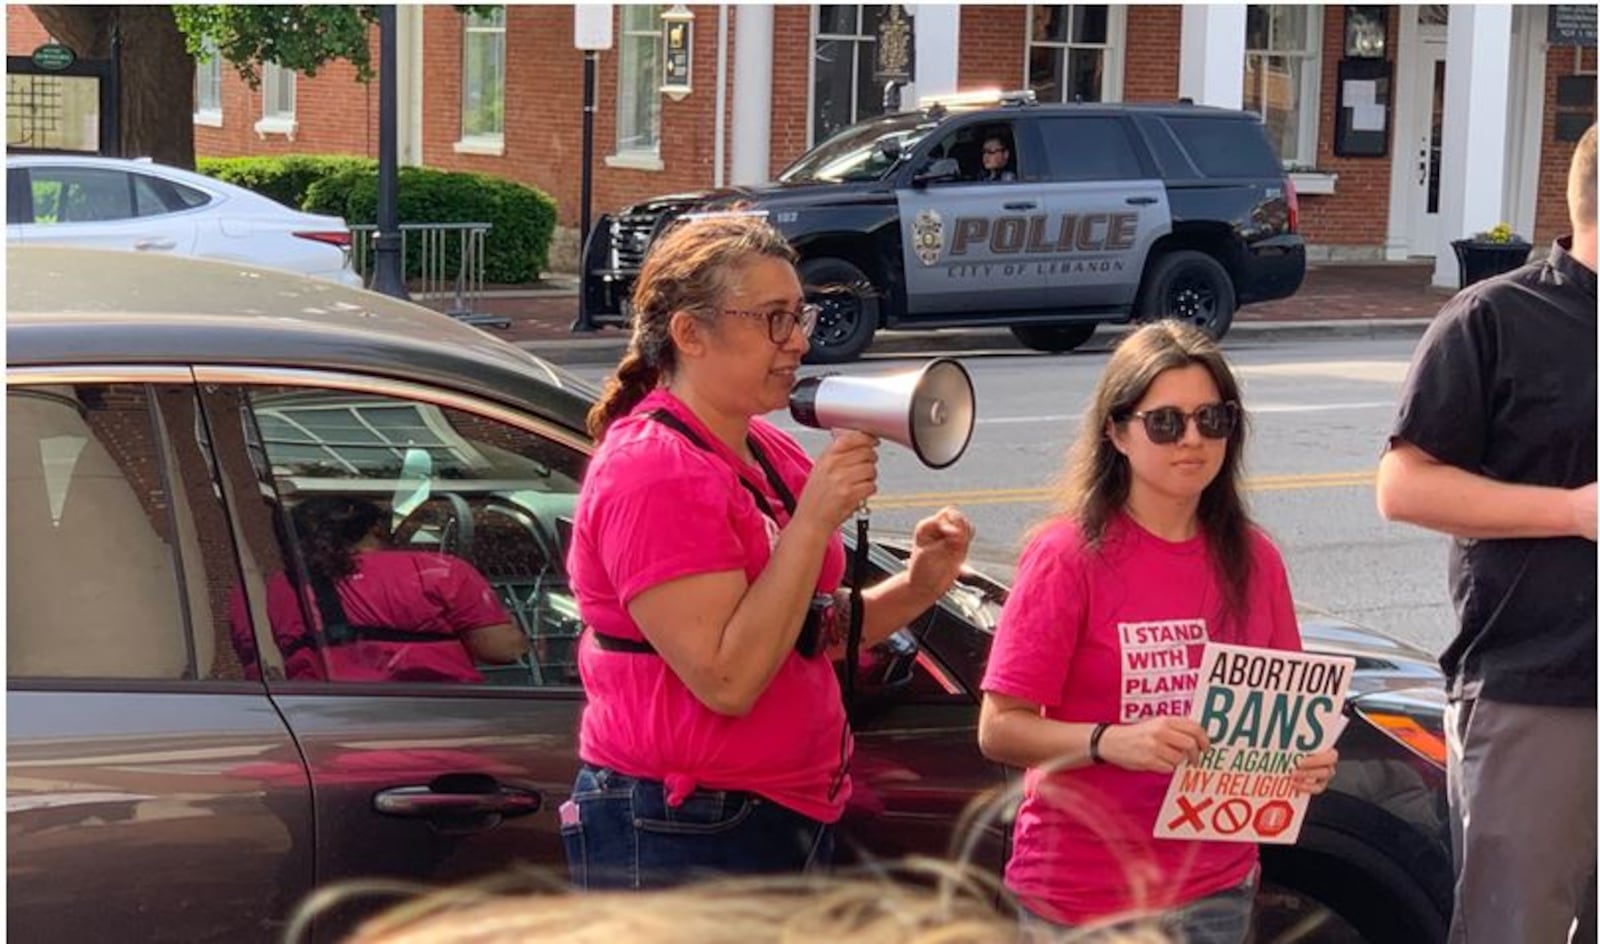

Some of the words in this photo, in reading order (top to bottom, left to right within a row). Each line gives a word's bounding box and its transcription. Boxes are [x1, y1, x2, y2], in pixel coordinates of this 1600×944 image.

[950, 212, 1139, 256] POLICE
[947, 264, 992, 279] CITY
[1003, 264, 1029, 277] OF
[1037, 260, 1124, 276] LEBANON
[1123, 626, 1130, 644] I
[1135, 623, 1204, 644] STAND
[1127, 649, 1184, 670] WITH
[1208, 651, 1346, 696] ABORTION
[1201, 685, 1334, 752] BANS
[1186, 747, 1228, 772] RE
[1229, 749, 1311, 775] AGAINS
[1179, 769, 1216, 793] MY
